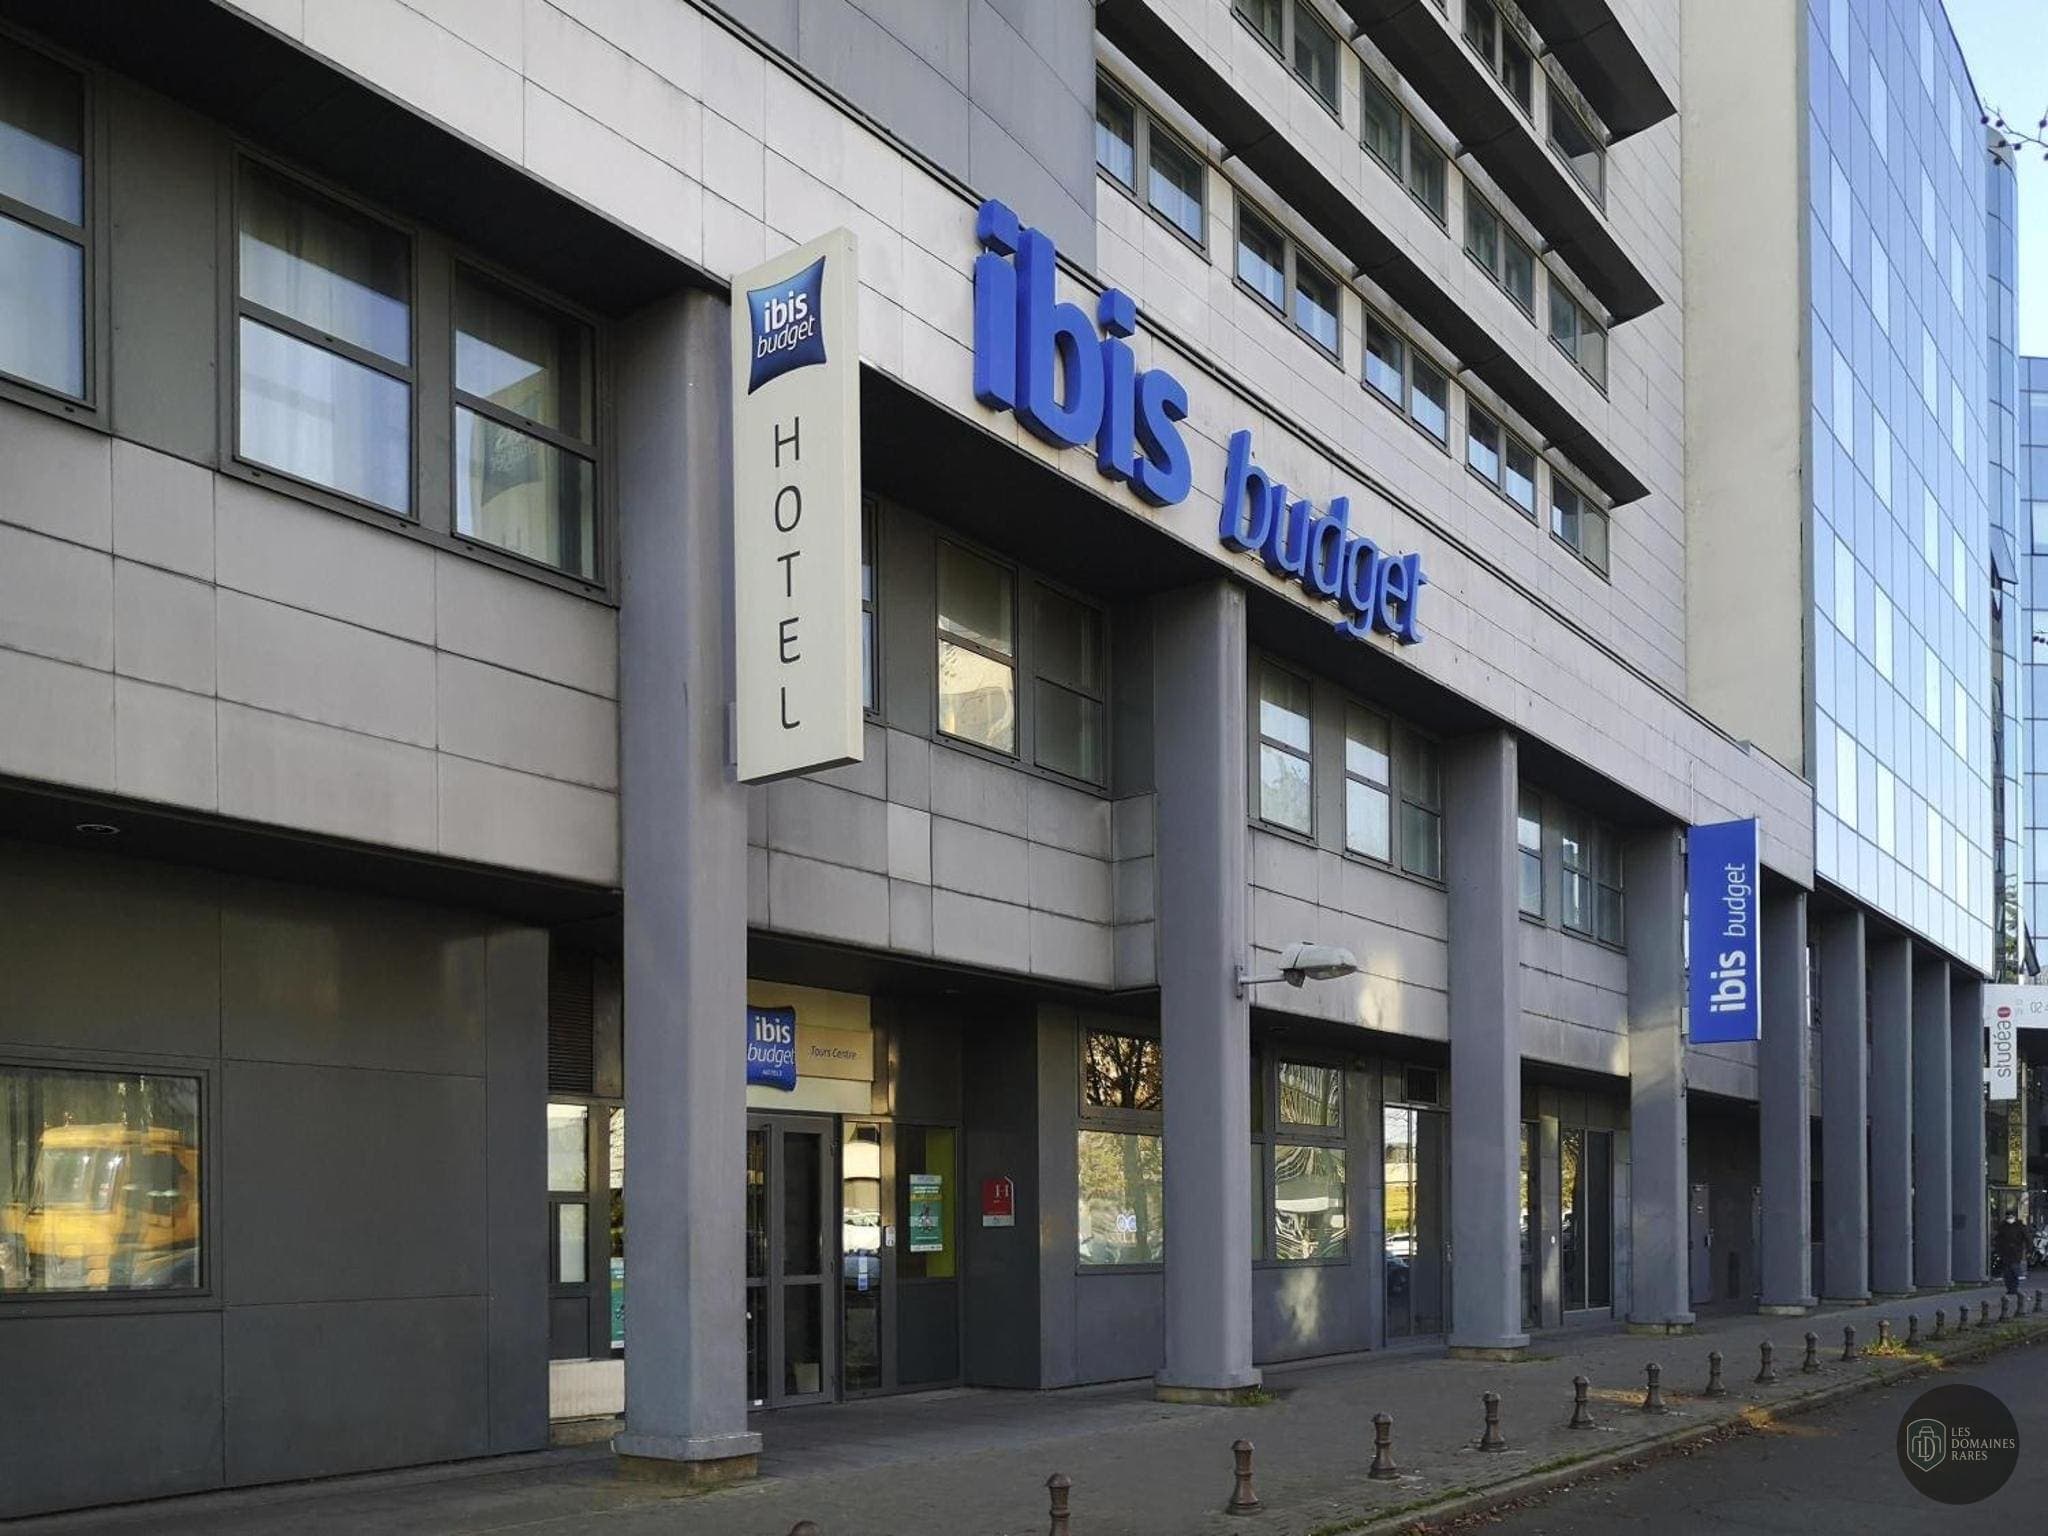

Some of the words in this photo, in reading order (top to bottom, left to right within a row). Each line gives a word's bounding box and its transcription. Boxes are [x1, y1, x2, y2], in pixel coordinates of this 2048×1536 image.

[757, 314, 816, 358] budget
[764, 291, 807, 333] ibis
[973, 199, 1192, 507] ibis
[1218, 428, 1427, 646] budget
[773, 415, 802, 730] HOTEL
[1721, 862, 1751, 938] budget
[1709, 949, 1747, 1013] ibis
[747, 1043, 795, 1068] budget
[755, 1015, 791, 1044] ibis
[1993, 1020, 2011, 1077] studéa
